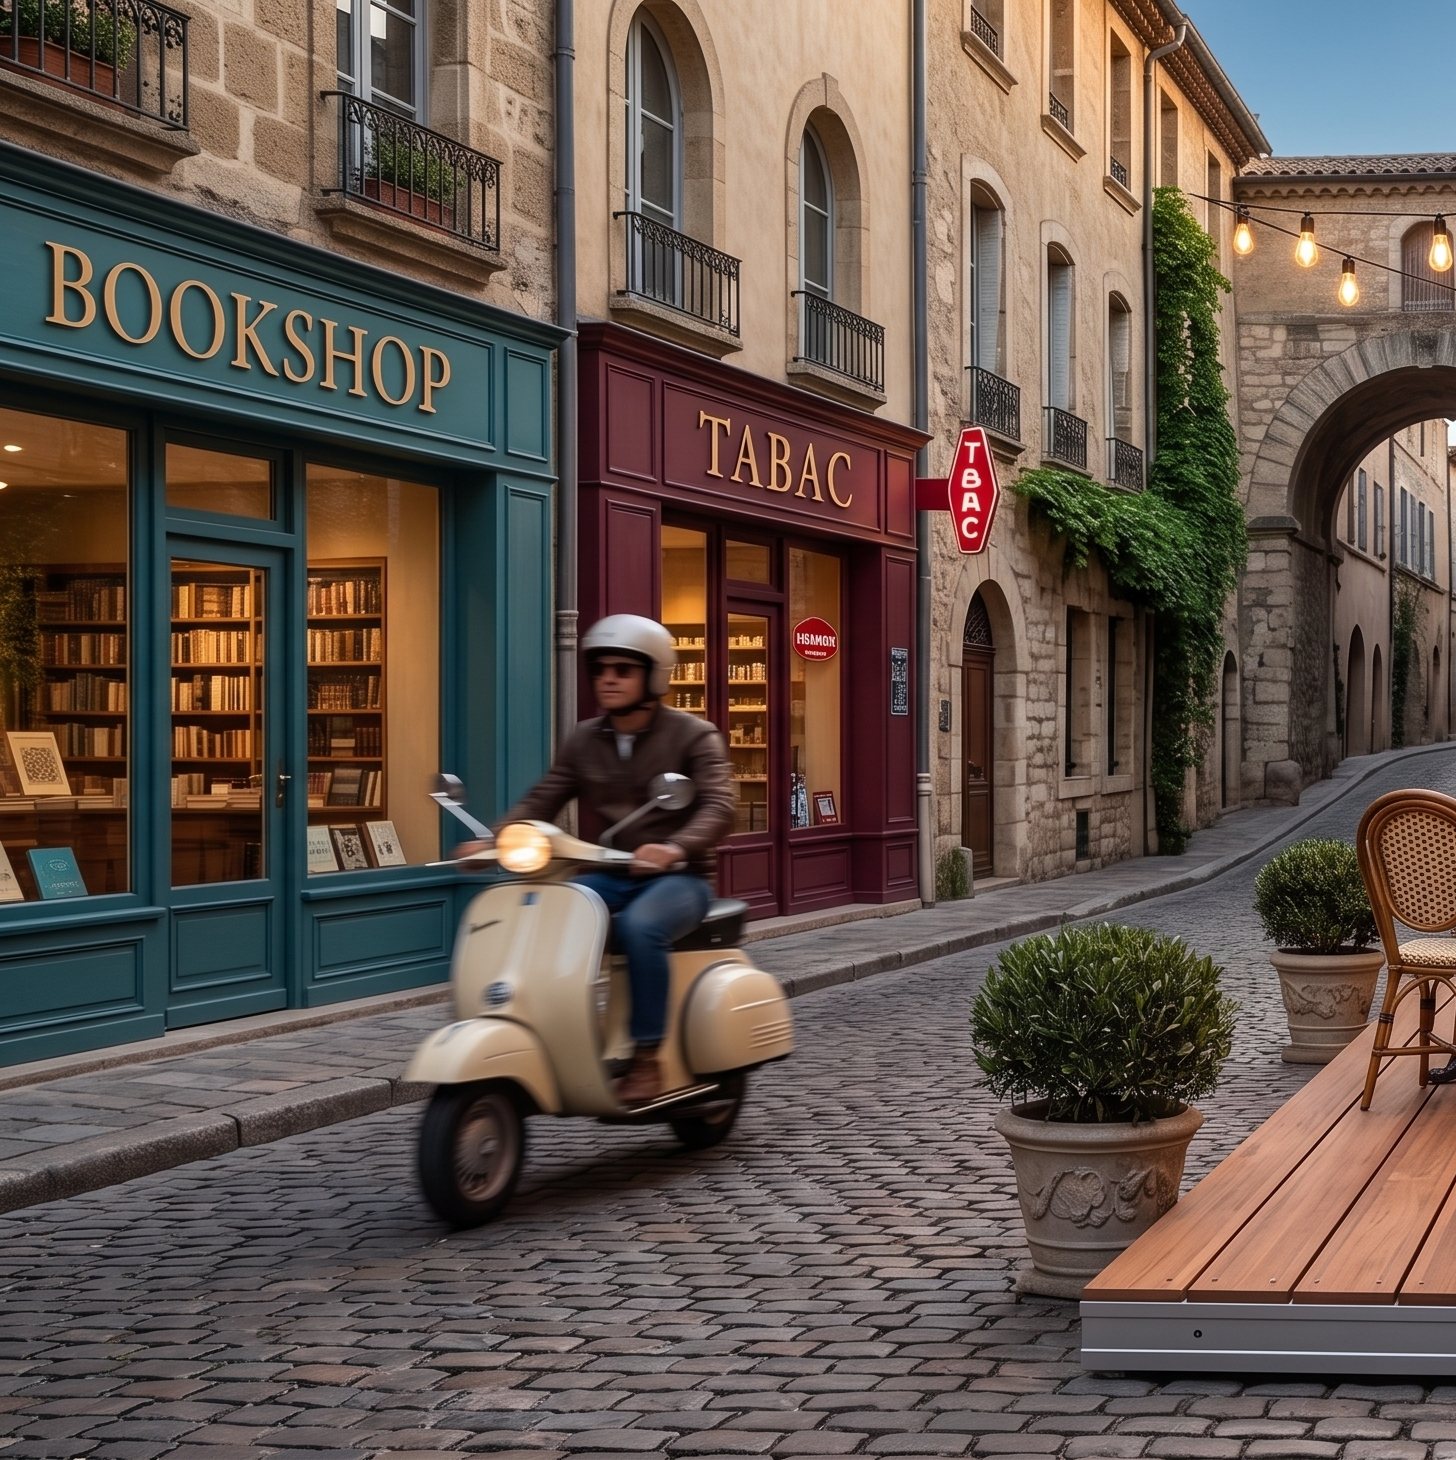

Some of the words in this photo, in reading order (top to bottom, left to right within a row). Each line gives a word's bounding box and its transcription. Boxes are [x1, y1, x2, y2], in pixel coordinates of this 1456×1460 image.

[45, 241, 452, 415] BOOKSHOP
[699, 410, 853, 508] TABAC
[961, 441, 982, 539] TBAC
